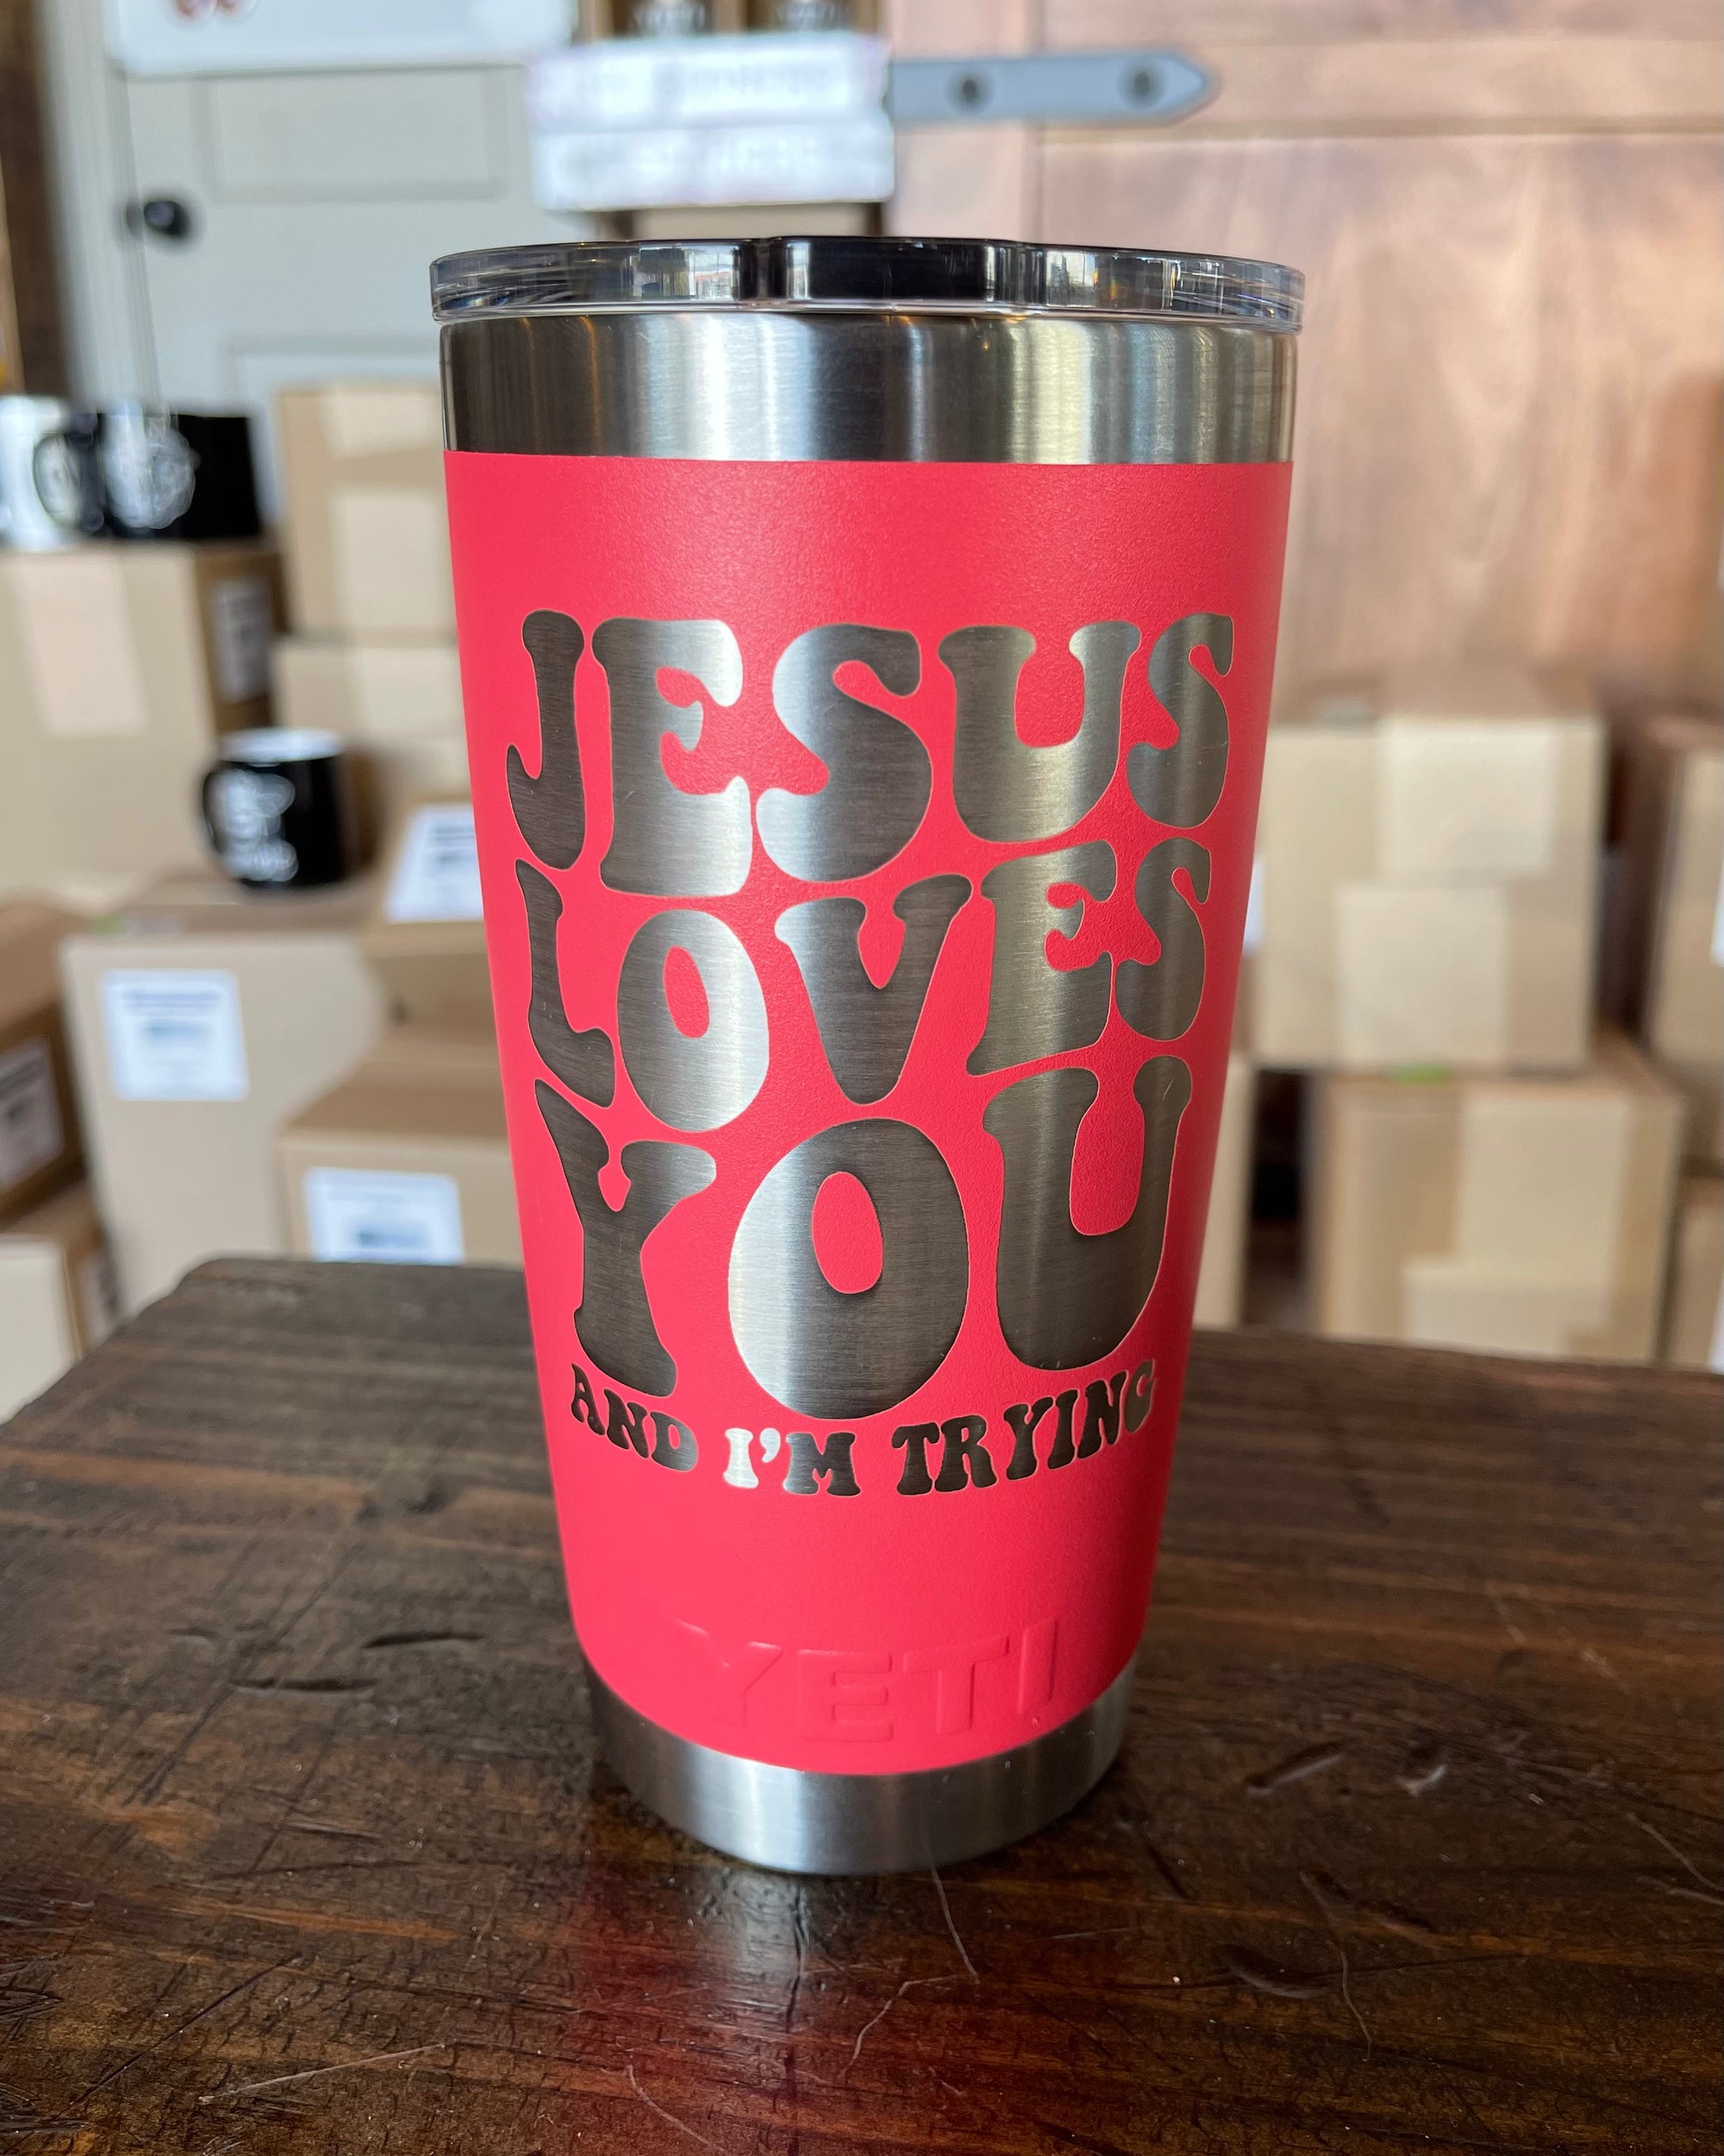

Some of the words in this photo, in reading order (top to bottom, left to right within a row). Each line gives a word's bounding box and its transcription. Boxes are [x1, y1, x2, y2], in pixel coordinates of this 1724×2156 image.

[506, 609, 1234, 897] JESUS
[515, 836, 1212, 1133] LOVES
[534, 1054, 1193, 1421] YOU
[570, 1362, 699, 1472] AND
[724, 1427, 862, 1497] I'M
[890, 1358, 1157, 1497] TRYING
[675, 1617, 1059, 1743] YETI
